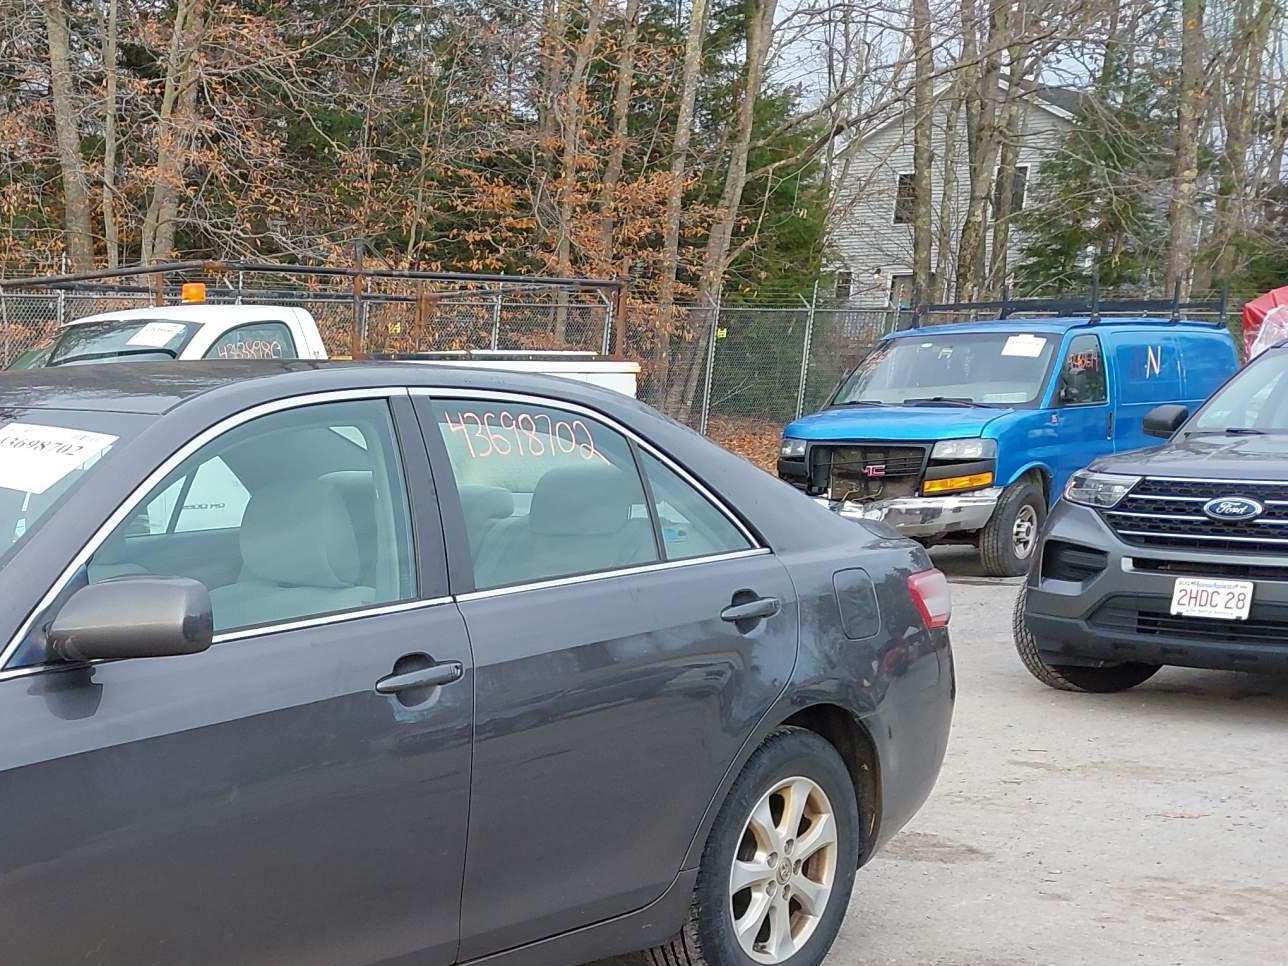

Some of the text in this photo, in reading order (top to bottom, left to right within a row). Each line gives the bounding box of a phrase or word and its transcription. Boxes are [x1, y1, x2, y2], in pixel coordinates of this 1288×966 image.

[444, 411, 611, 465] 43698702
[1215, 501, 1249, 514] Ford
[1177, 588, 1247, 610] 2HDC 28
